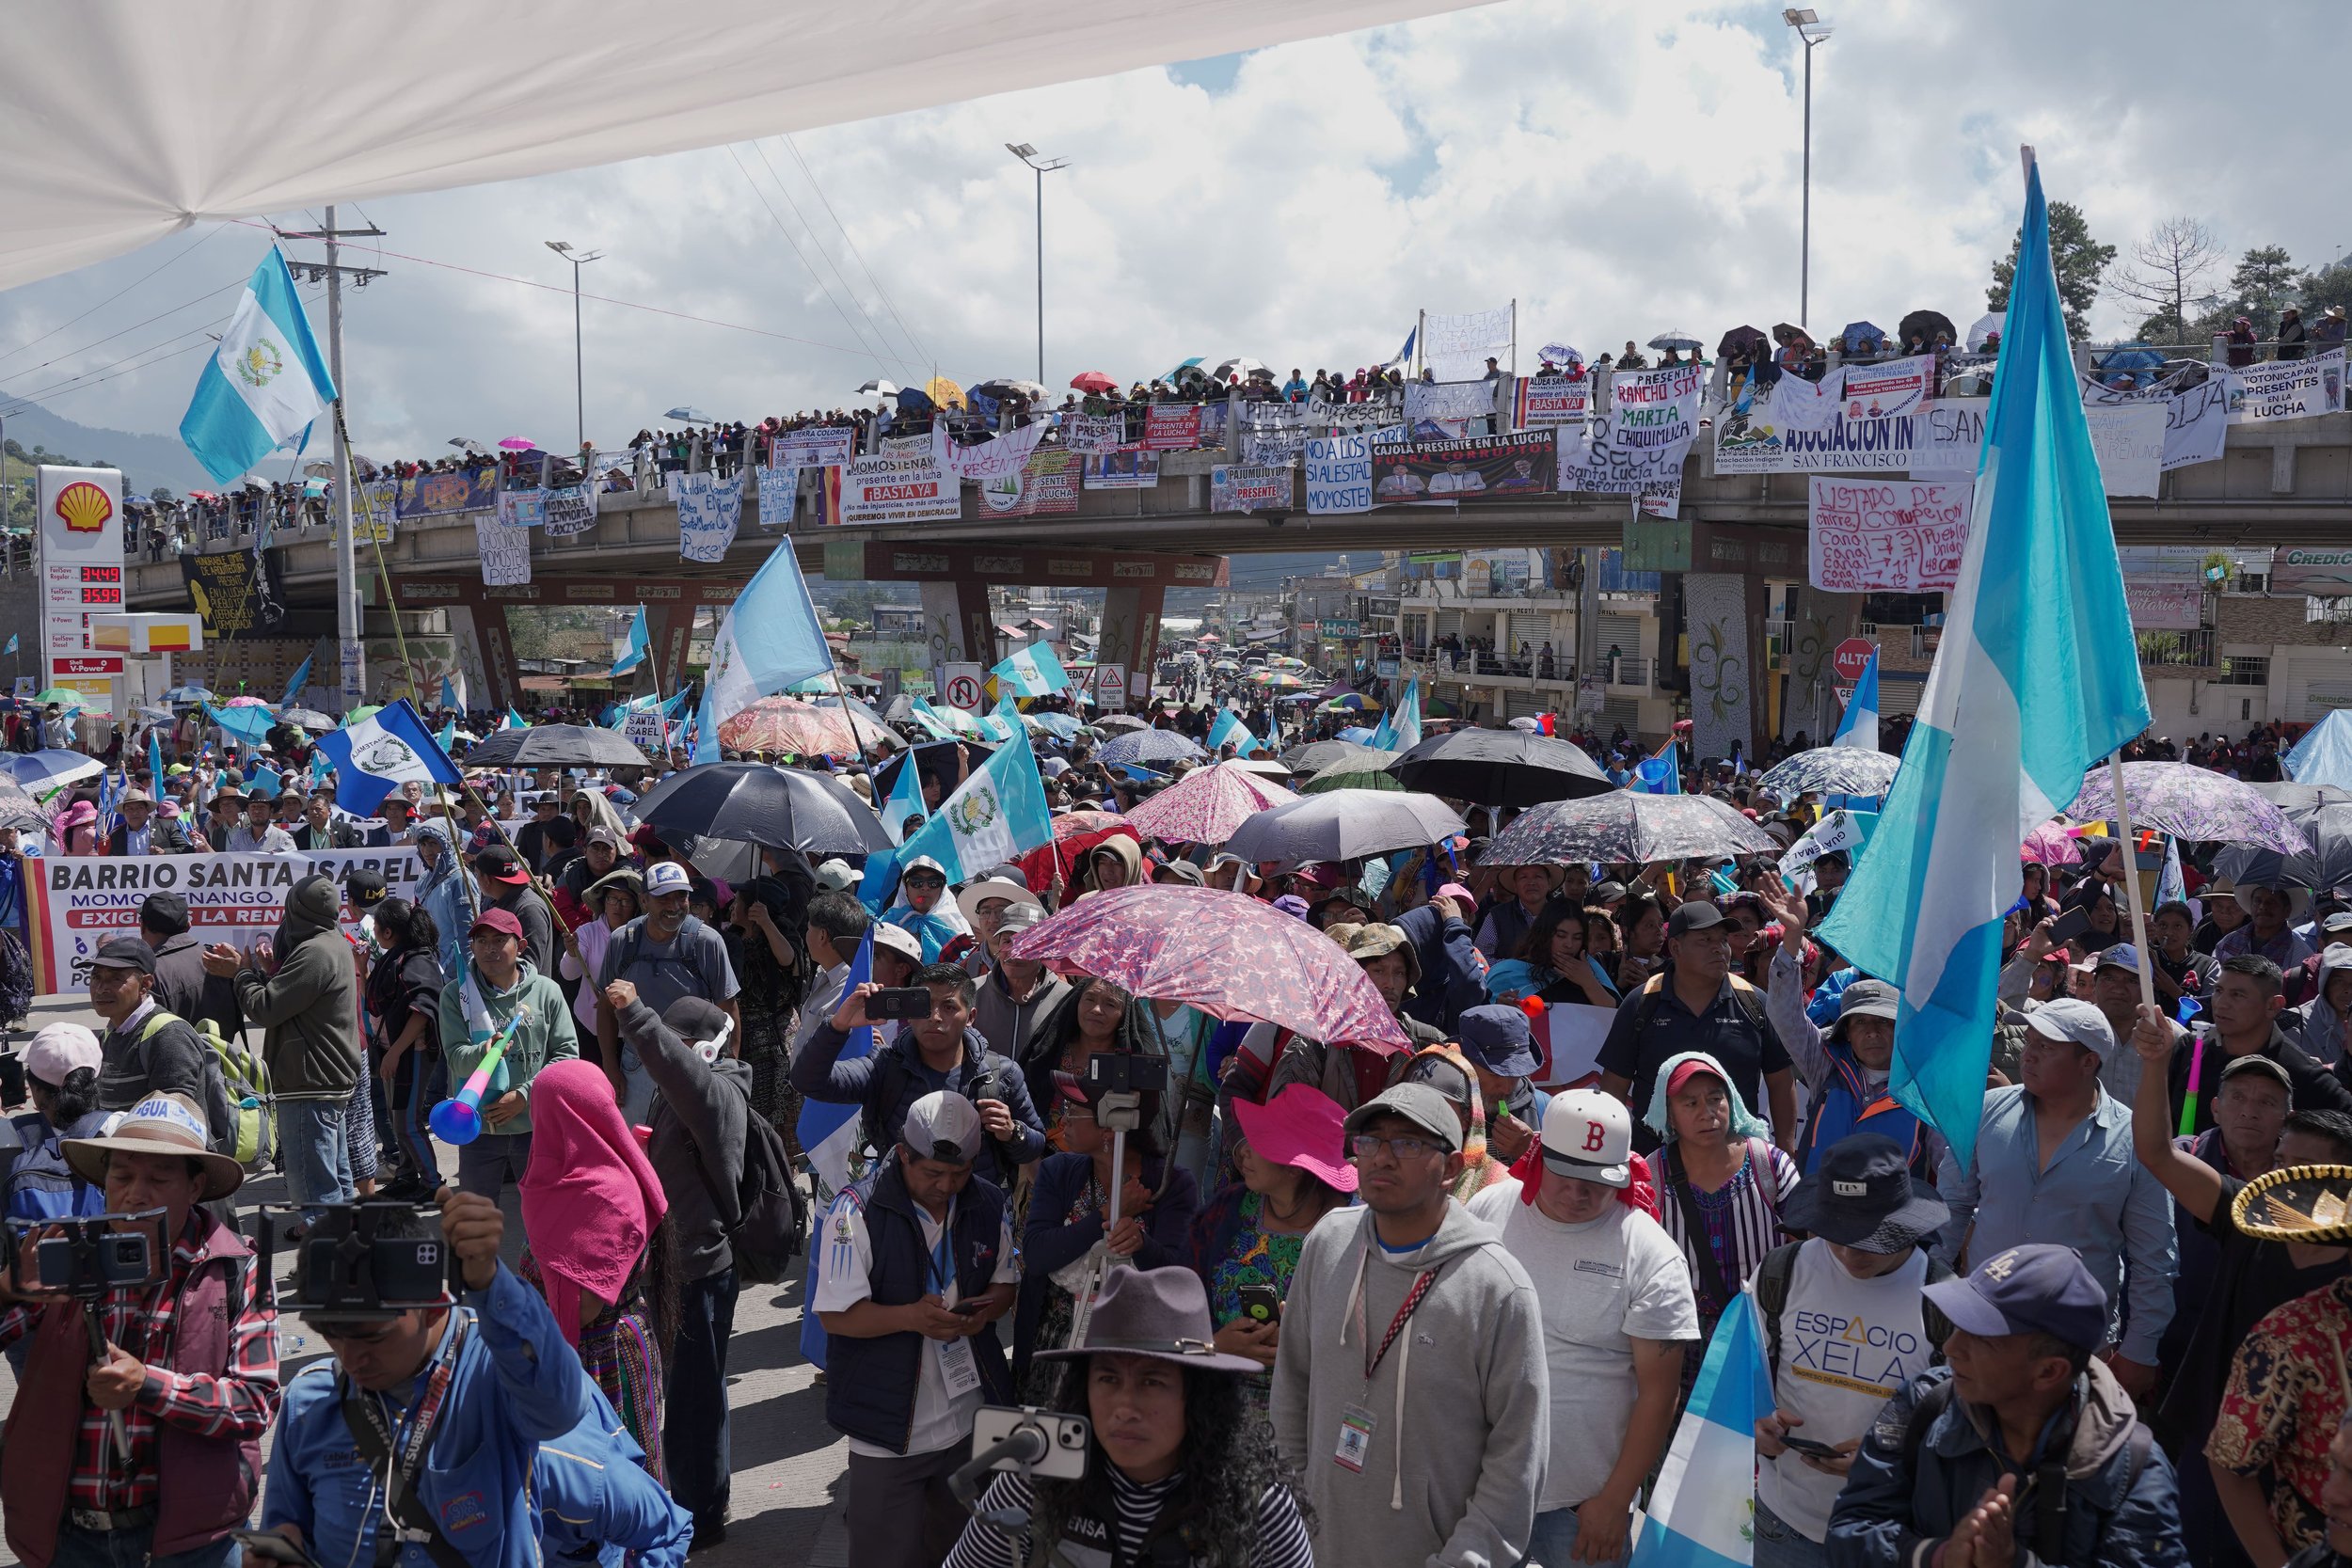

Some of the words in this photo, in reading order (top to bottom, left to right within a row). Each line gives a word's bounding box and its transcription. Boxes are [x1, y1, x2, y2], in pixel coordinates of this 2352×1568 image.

[1849, 369, 1914, 382] HUEHUETENANGO
[2244, 366, 2318, 384] TOTONICAPÁN
[1618, 384, 1667, 403] RANCHO
[2247, 376, 2319, 395] PRESENTES
[1528, 391, 1552, 400] presente
[1565, 398, 1580, 408] YA!
[1883, 388, 1922, 418] RENUNCIEN
[1247, 403, 1302, 419] PITZAL
[1622, 406, 1678, 426] MARIA
[2254, 402, 2306, 418] LUCHA
[1305, 440, 1323, 459] NO
[1326, 439, 1337, 460] A
[1340, 436, 1364, 459] LOS
[1417, 439, 1471, 453] PRESENTE
[1475, 437, 1491, 448] EN
[1495, 436, 1509, 446] LA
[1513, 431, 1552, 445] LUCHA
[1375, 453, 1431, 466] FUERA
[1441, 442, 1553, 461] CORRUPTOS
[1793, 455, 1820, 467] SAN
[1824, 453, 1907, 467] FRANCISCO
[856, 475, 896, 488] presente
[913, 471, 920, 481] la
[923, 470, 942, 480] lucha
[1566, 466, 1607, 481] Santa
[869, 484, 914, 501] ¡BASTA
[1237, 486, 1277, 499] PRESENTE
[1577, 479, 1642, 491] Reforma
[1044, 489, 1073, 498] LUCHA
[1818, 483, 1895, 513] LISTADO
[1897, 531, 1915, 546] 3
[2123, 585, 2161, 597] Servicio
[629, 715, 656, 725] SANTA
[626, 727, 659, 736] ISABEL
[52, 863, 177, 890] BARRIO
[186, 862, 294, 888] SANTA
[308, 858, 418, 883] ISABEL
[72, 892, 279, 906] MOMOENANGO,
[208, 910, 235, 924] LA
[1581, 1121, 1605, 1152] B
[1792, 1334, 1905, 1383] XELA
